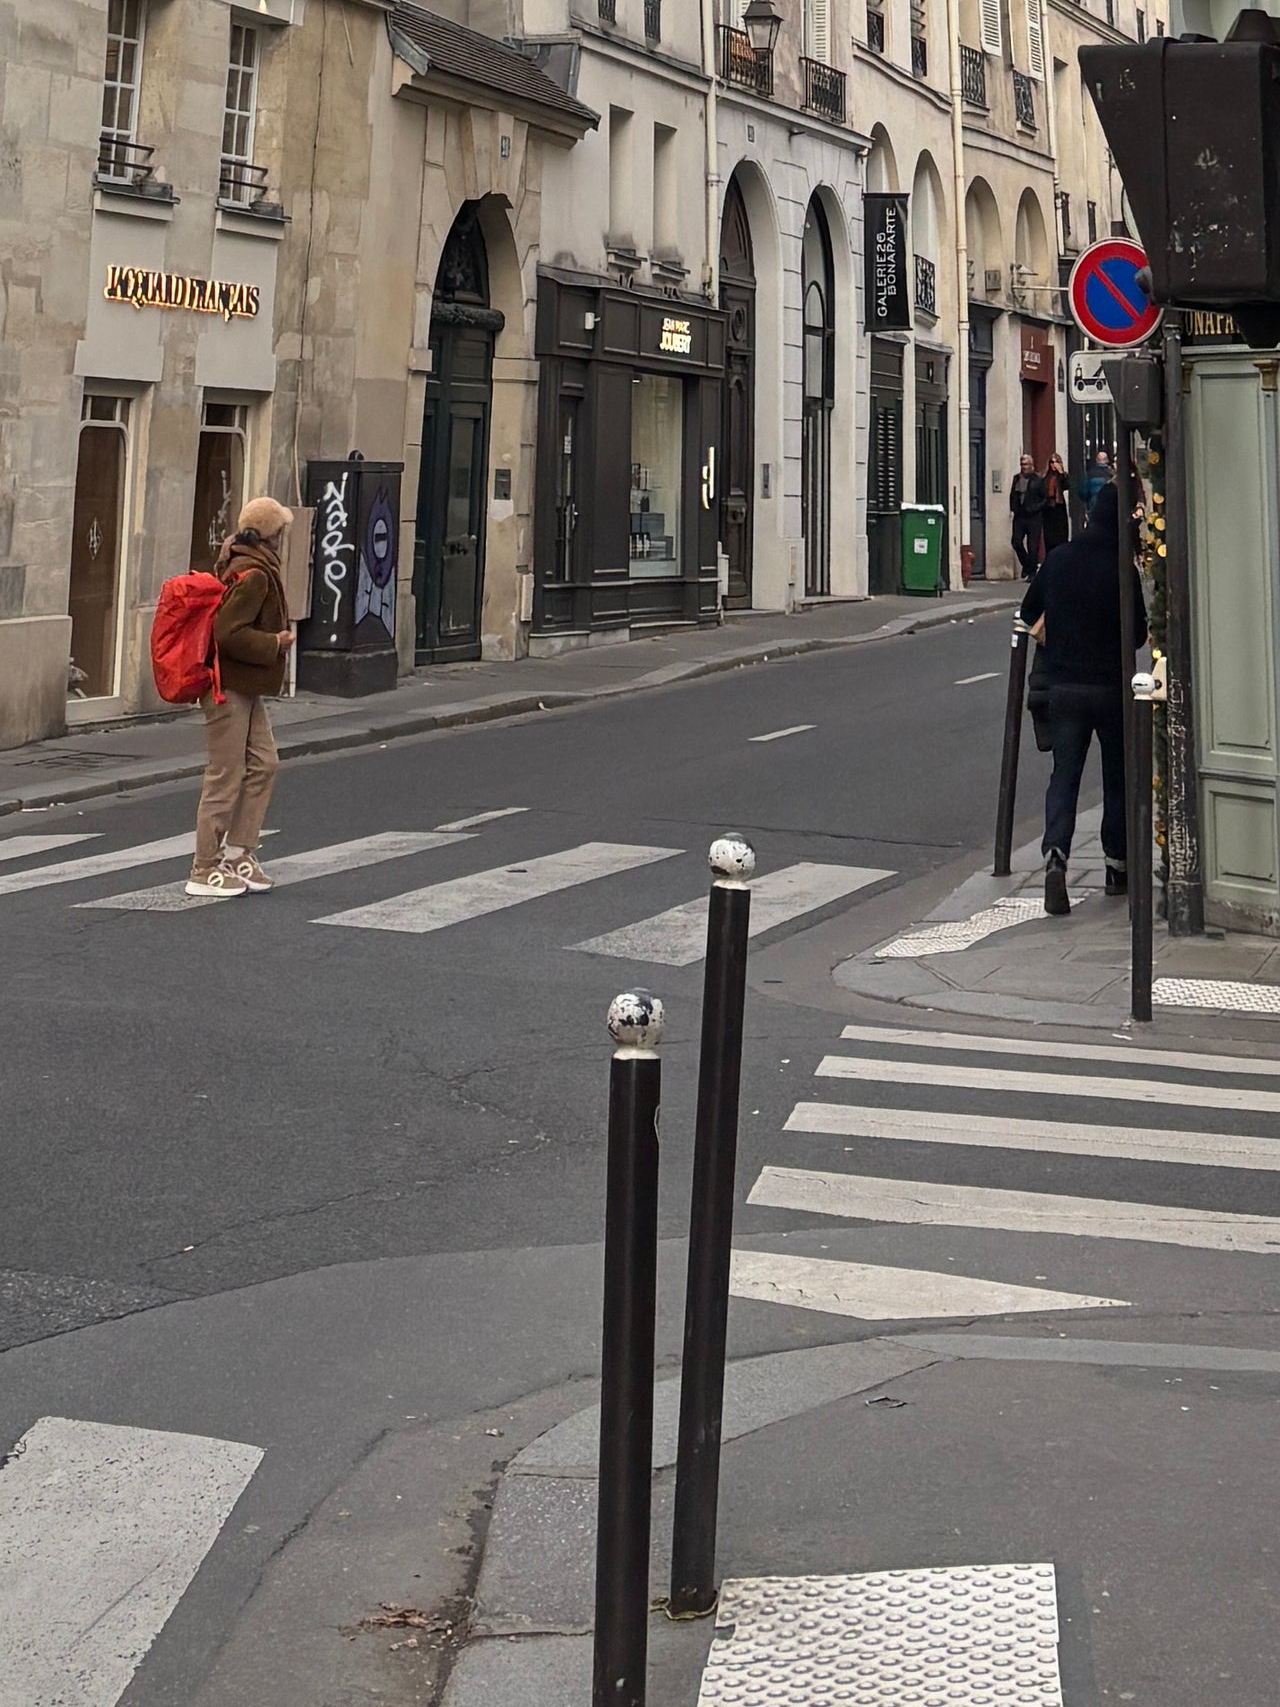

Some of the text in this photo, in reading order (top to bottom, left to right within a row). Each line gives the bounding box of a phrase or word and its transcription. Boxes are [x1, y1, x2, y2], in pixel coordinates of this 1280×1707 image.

[886, 207, 897, 296] BONAPARTE
[103, 264, 261, 323] JACQUARD FRANÇAIS
